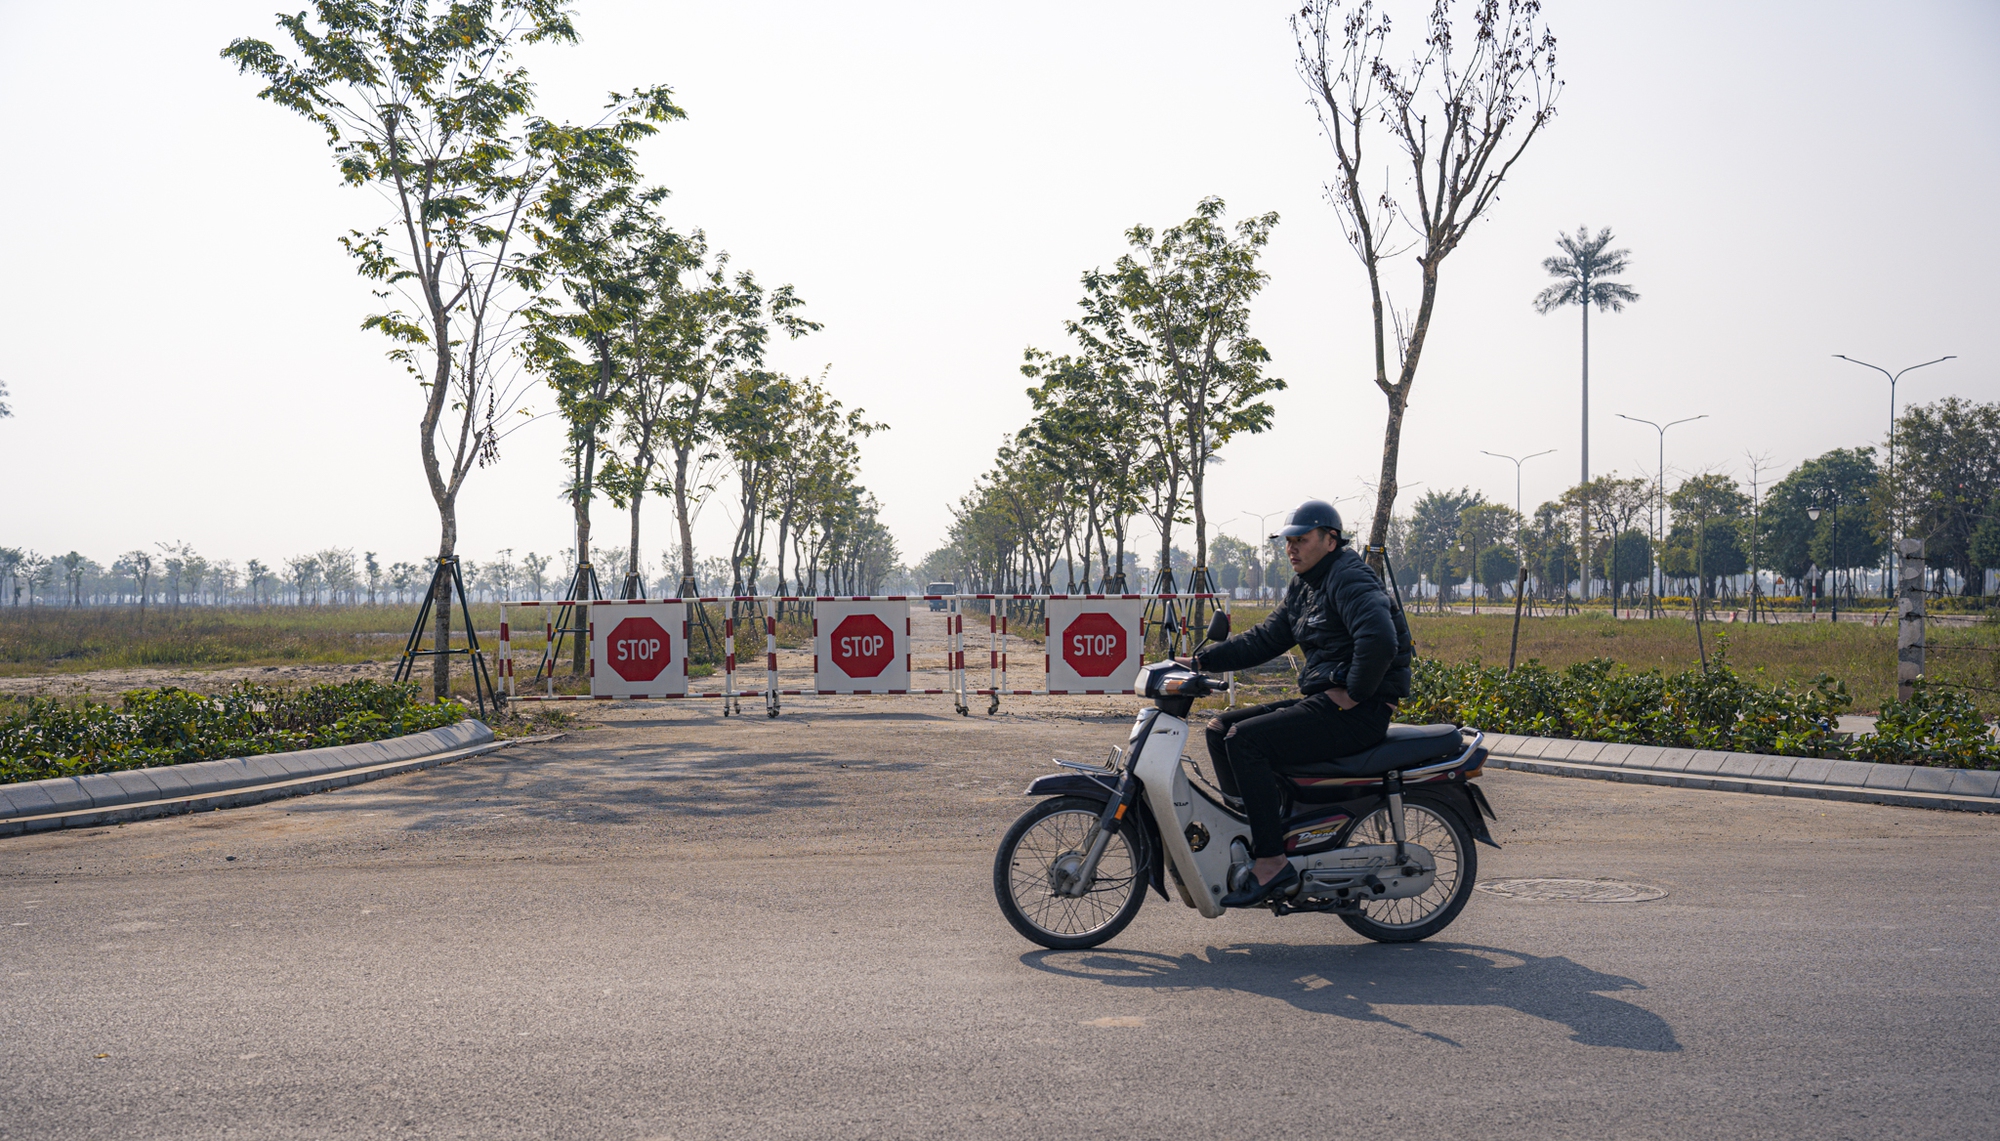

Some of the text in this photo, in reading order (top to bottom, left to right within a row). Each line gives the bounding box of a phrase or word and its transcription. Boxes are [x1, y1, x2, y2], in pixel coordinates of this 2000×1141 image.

[617, 639, 660, 660] STOP
[841, 635, 884, 657] STOP
[1073, 634, 1117, 656] STOP
